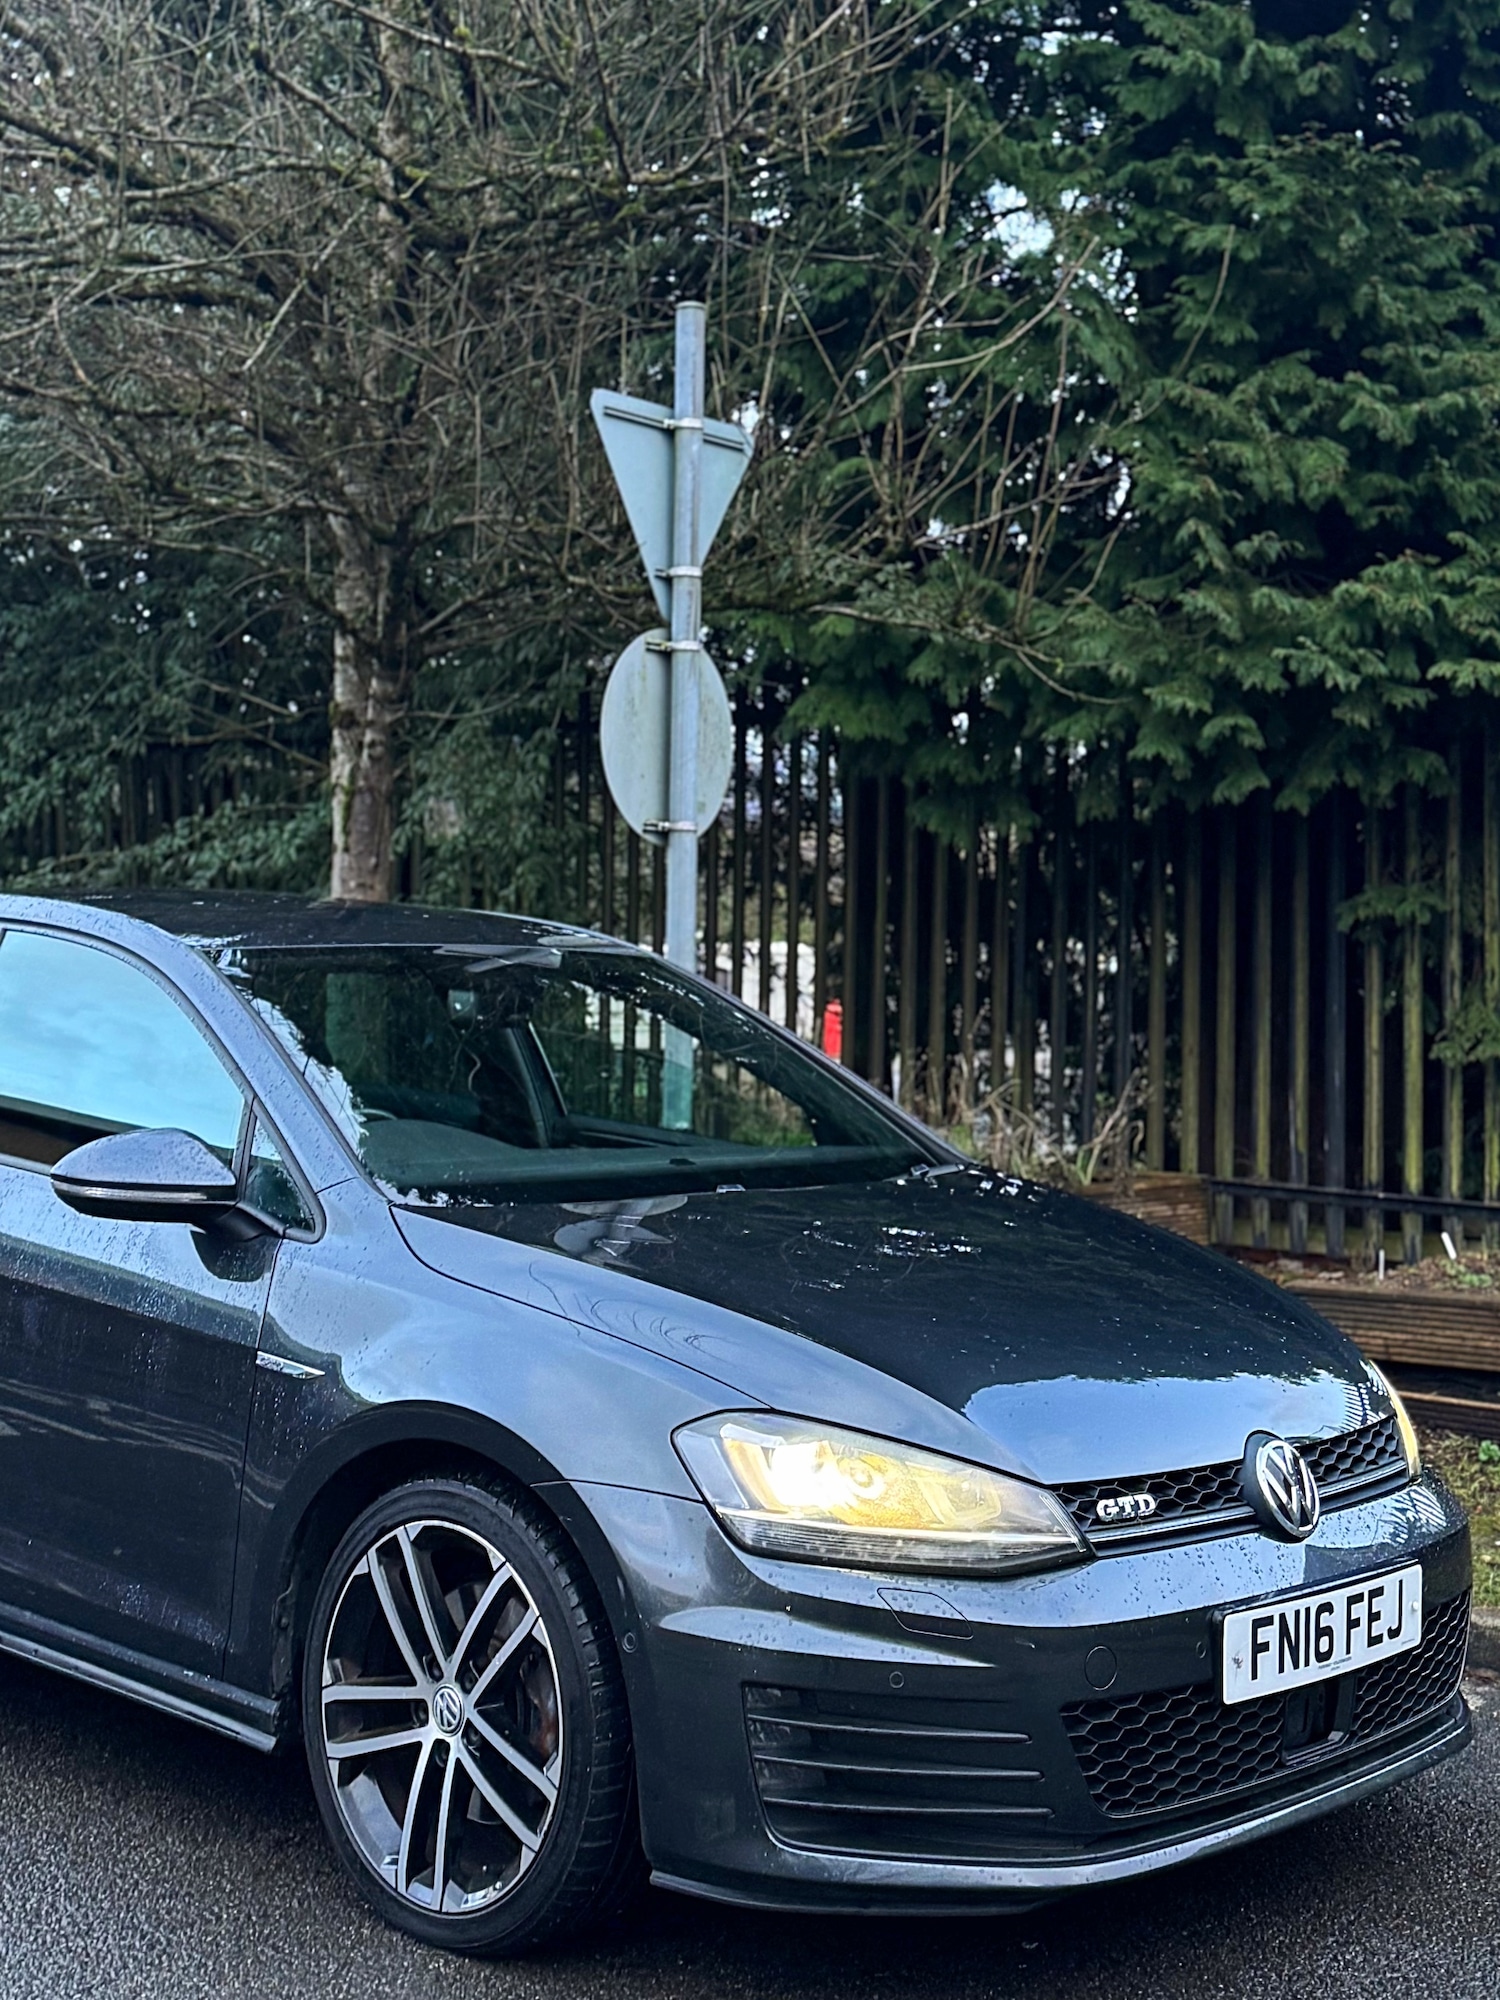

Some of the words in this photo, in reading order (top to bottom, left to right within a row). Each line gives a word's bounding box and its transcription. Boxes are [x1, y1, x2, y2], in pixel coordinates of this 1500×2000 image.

[1096, 1494, 1156, 1522] GTD
[1251, 1601, 1334, 1681] FN16
[1345, 1579, 1403, 1656] FEJ
